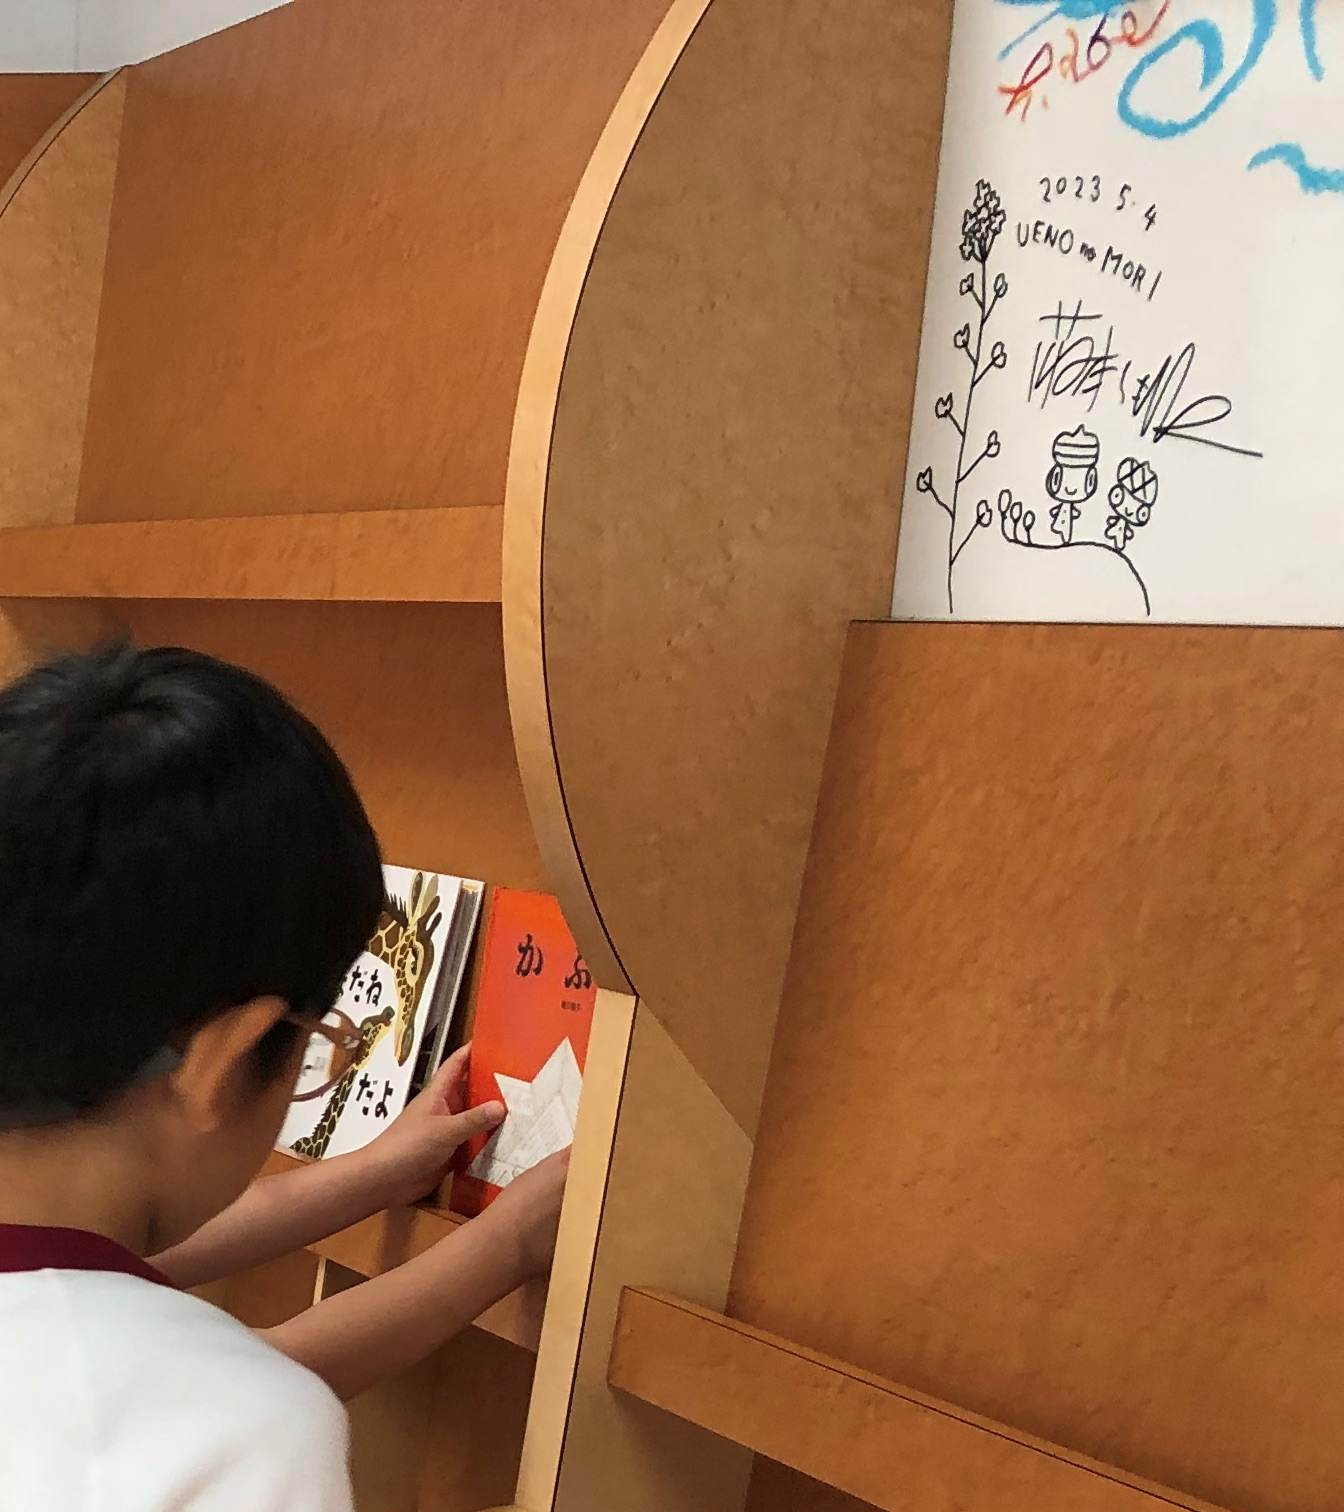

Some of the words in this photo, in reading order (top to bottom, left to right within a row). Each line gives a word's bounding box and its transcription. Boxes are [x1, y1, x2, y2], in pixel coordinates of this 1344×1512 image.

[1016, 221, 1074, 255] UENO
[1101, 245, 1164, 303] MORI
[355, 1072, 394, 1120] だよ
